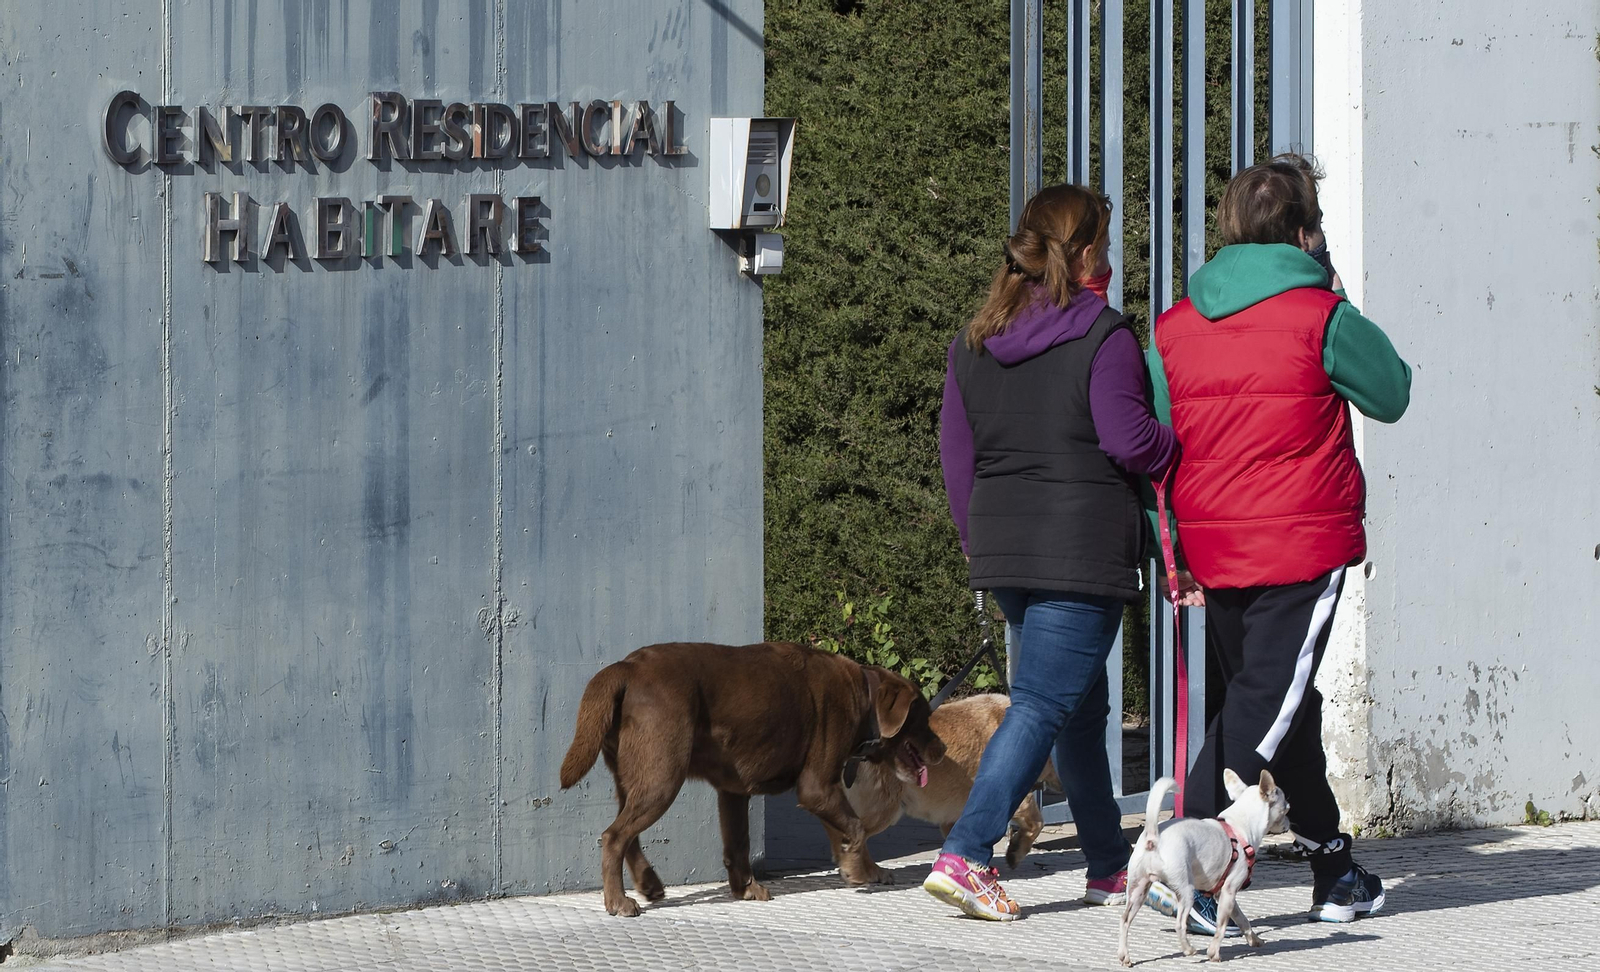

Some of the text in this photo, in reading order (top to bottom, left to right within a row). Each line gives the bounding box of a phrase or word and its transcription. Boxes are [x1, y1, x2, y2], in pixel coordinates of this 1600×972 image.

[103, 90, 689, 164] CENTRO RESIDENCIAL
[204, 191, 542, 262] HABITARE
